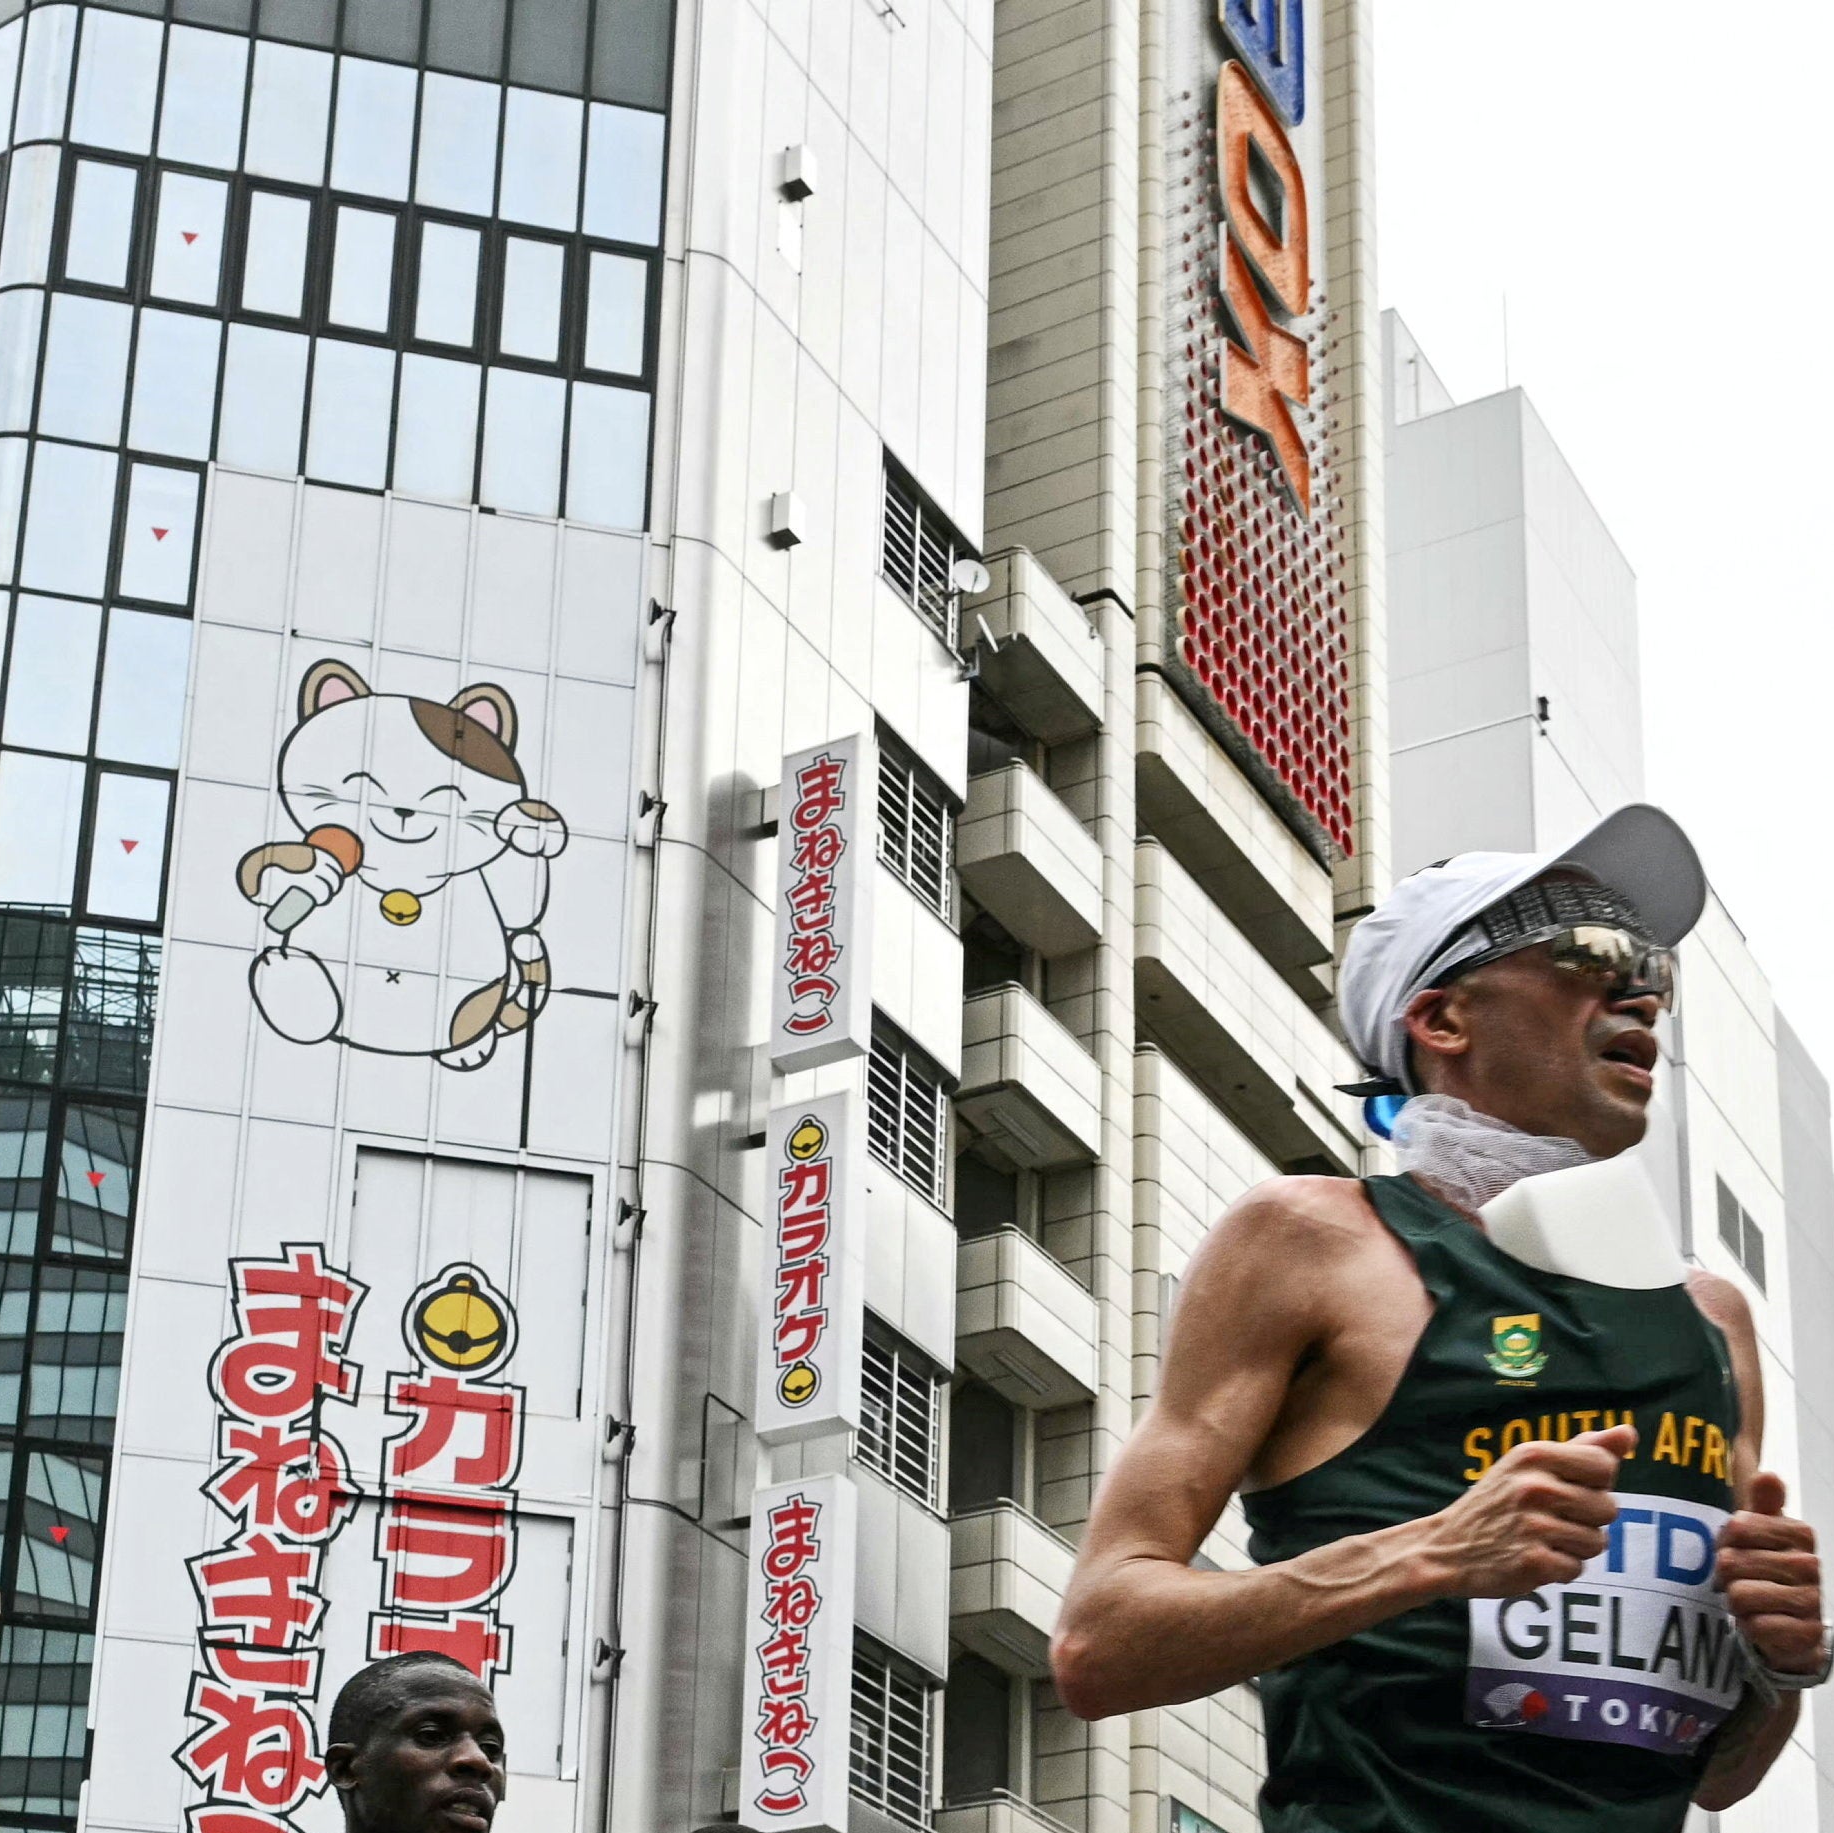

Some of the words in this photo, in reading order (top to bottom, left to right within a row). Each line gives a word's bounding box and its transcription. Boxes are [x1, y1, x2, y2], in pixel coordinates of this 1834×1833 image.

[783, 752, 848, 1037] まねきねこ
[774, 1157, 834, 1366] カラオケ
[754, 1492, 823, 1818] まねきねこ
[1606, 1506, 1719, 1587] TD
